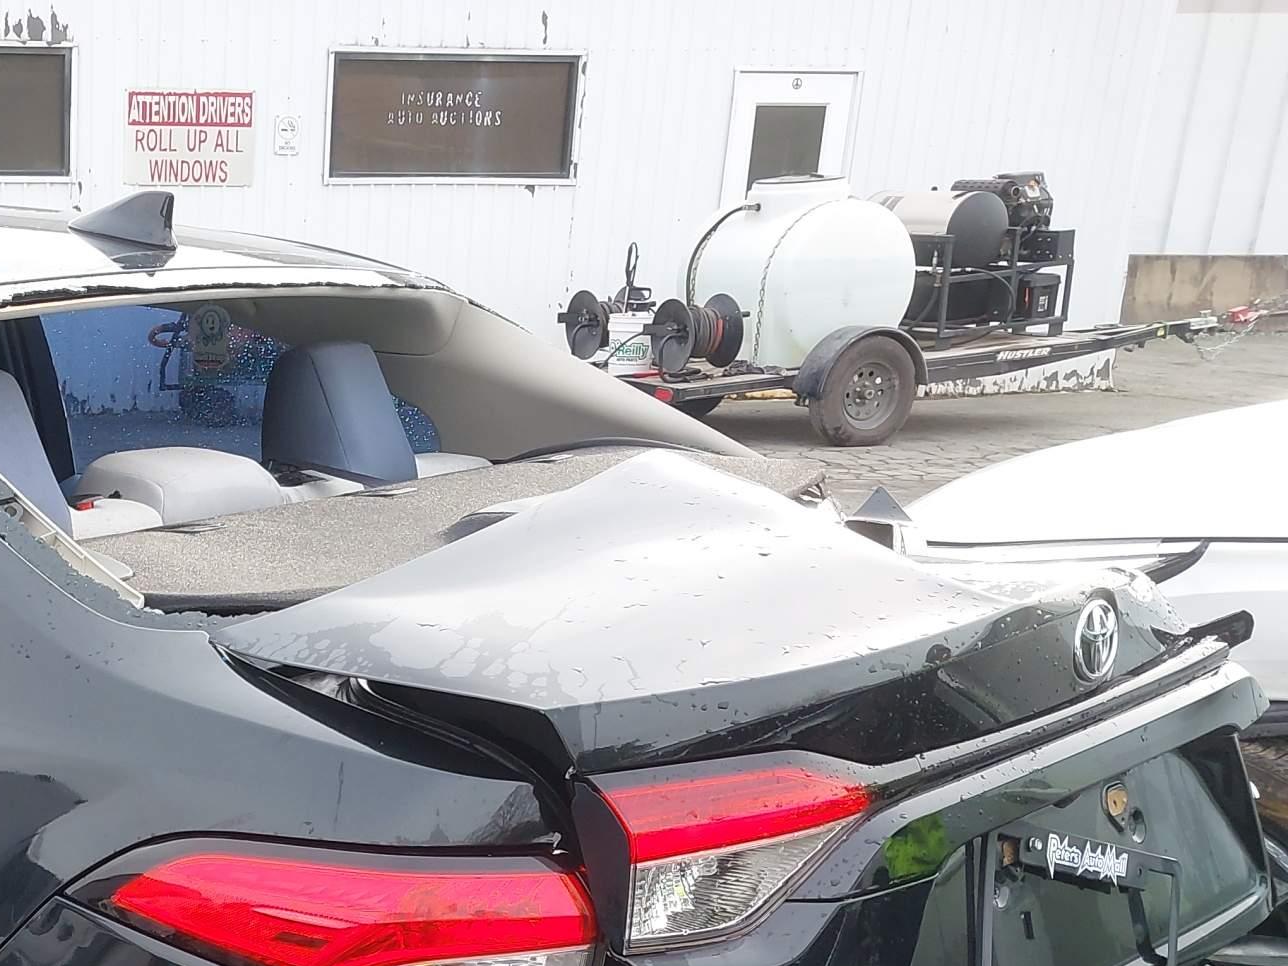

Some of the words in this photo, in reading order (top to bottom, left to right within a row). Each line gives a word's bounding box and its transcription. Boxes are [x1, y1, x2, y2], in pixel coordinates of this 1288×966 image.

[129, 95, 196, 123] ATTENTION
[199, 96, 251, 124] DRIVERS
[401, 91, 482, 107] INSURANCE
[135, 129, 177, 152] ROLL
[187, 130, 208, 152] UP
[214, 130, 243, 153] ALL
[149, 159, 228, 183] WINDOWS
[997, 347, 1051, 360] HUSTLER
